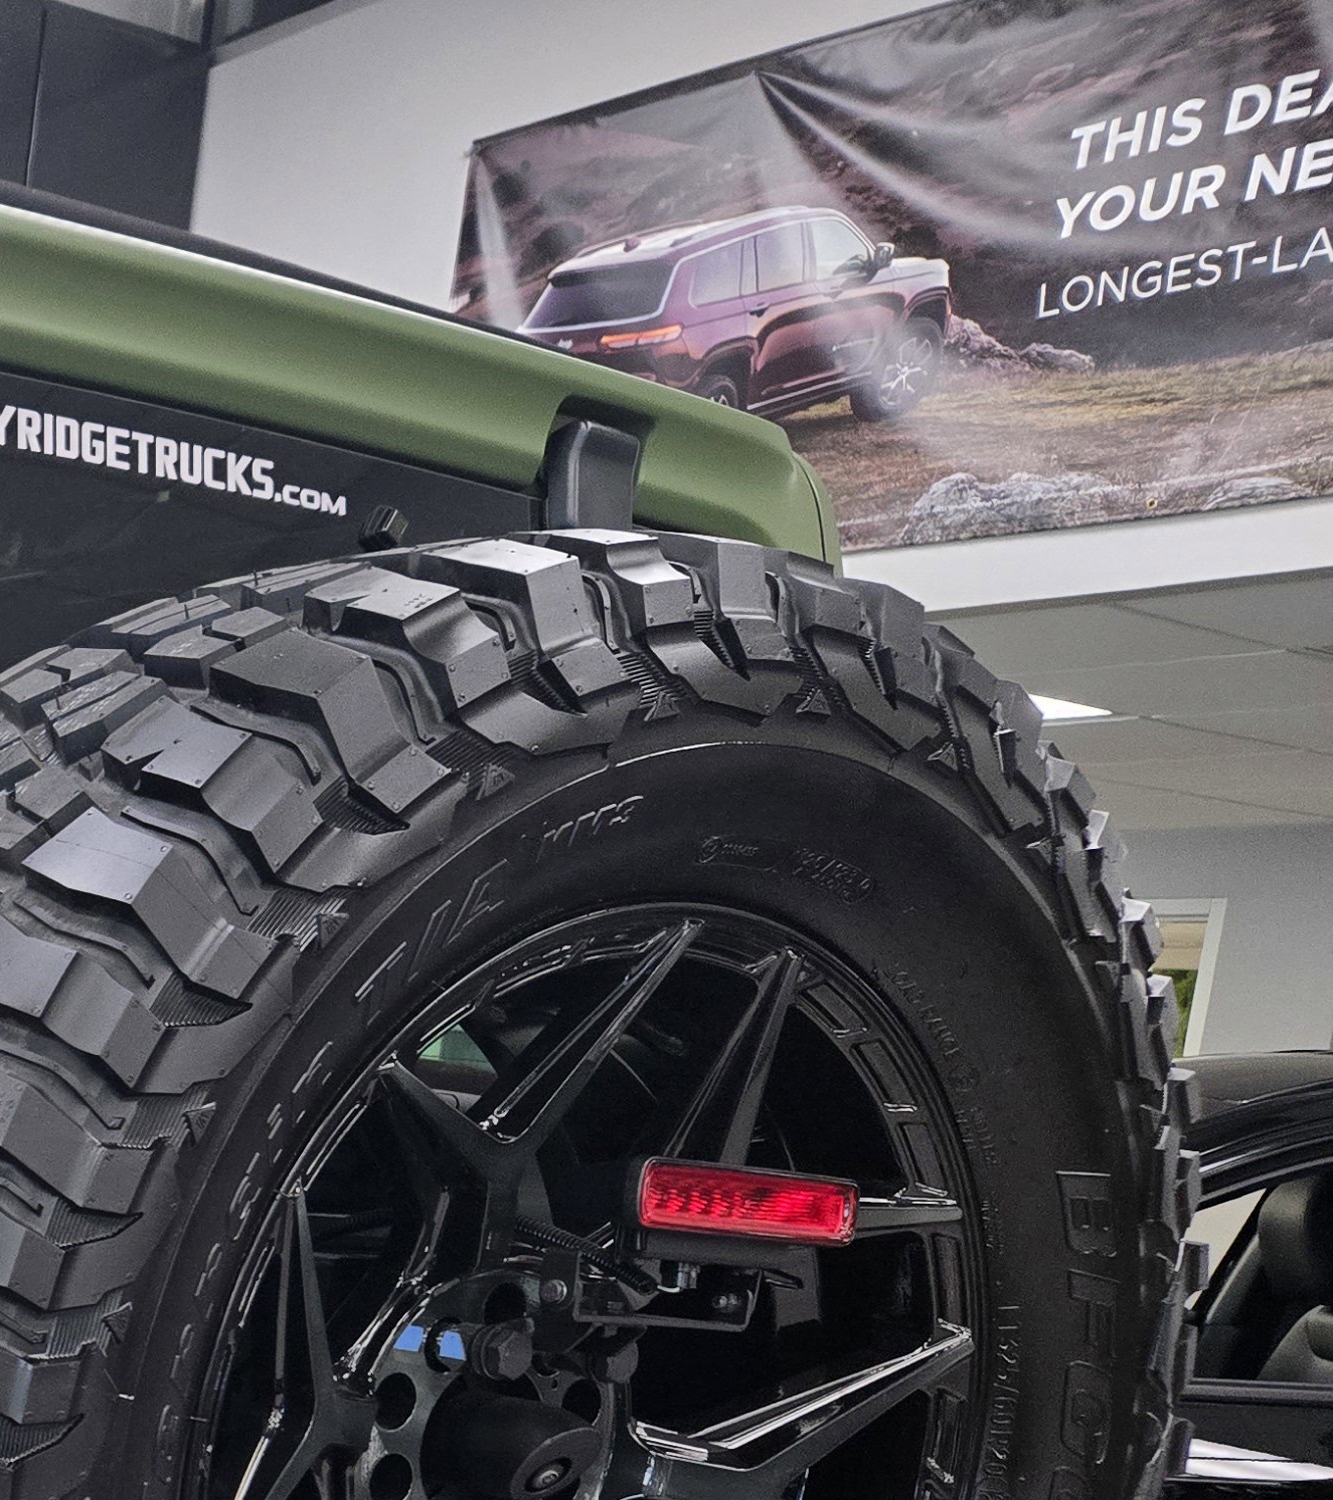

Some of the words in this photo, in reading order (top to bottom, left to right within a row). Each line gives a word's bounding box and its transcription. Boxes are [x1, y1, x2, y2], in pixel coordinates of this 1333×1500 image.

[1071, 98, 1206, 170] THIS
[1056, 164, 1226, 239] YOUR
[1037, 227, 1333, 319] LONGEST-LA
